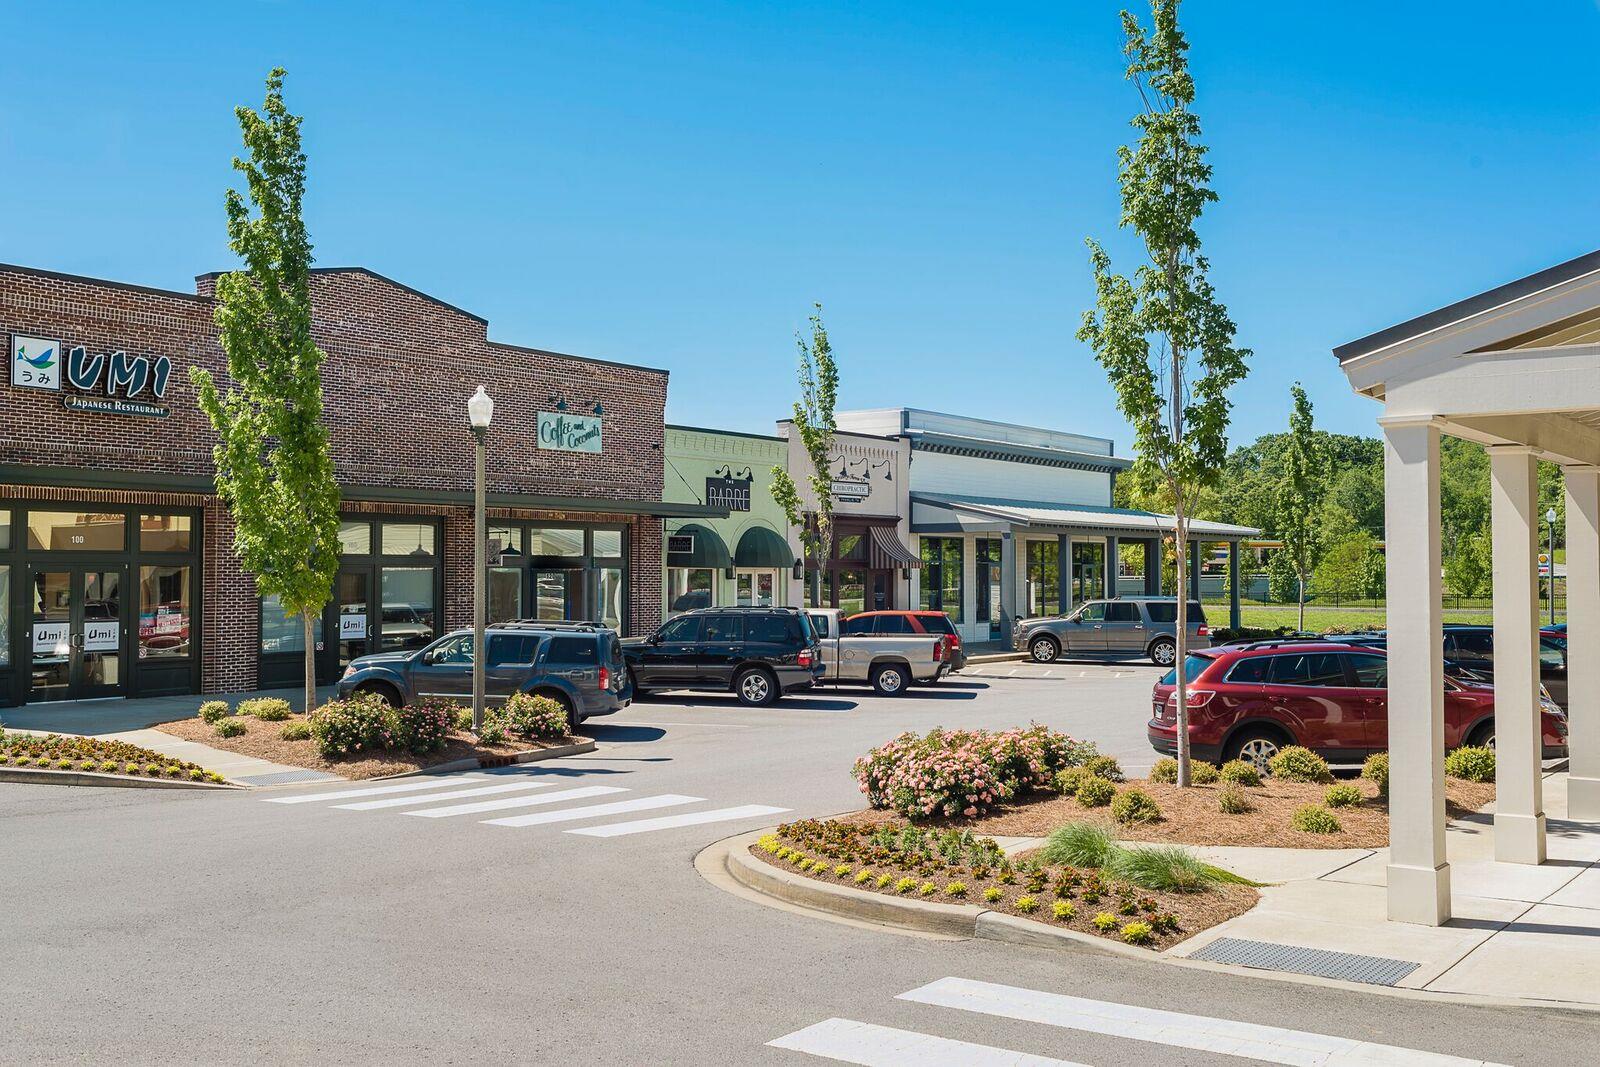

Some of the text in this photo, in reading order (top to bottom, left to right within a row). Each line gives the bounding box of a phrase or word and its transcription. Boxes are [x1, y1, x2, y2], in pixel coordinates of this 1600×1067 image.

[22, 371, 51, 384] うみ
[68, 346, 171, 398] UMI
[541, 416, 585, 448] Coffee and
[568, 425, 600, 448] Coconuts
[833, 485, 867, 493] CHIROPRACTIC
[709, 487, 750, 510] BARRE
[71, 535, 84, 543] 100
[343, 620, 361, 629] Umi
[37, 630, 62, 641] Umi
[88, 629, 111, 639] Umi
